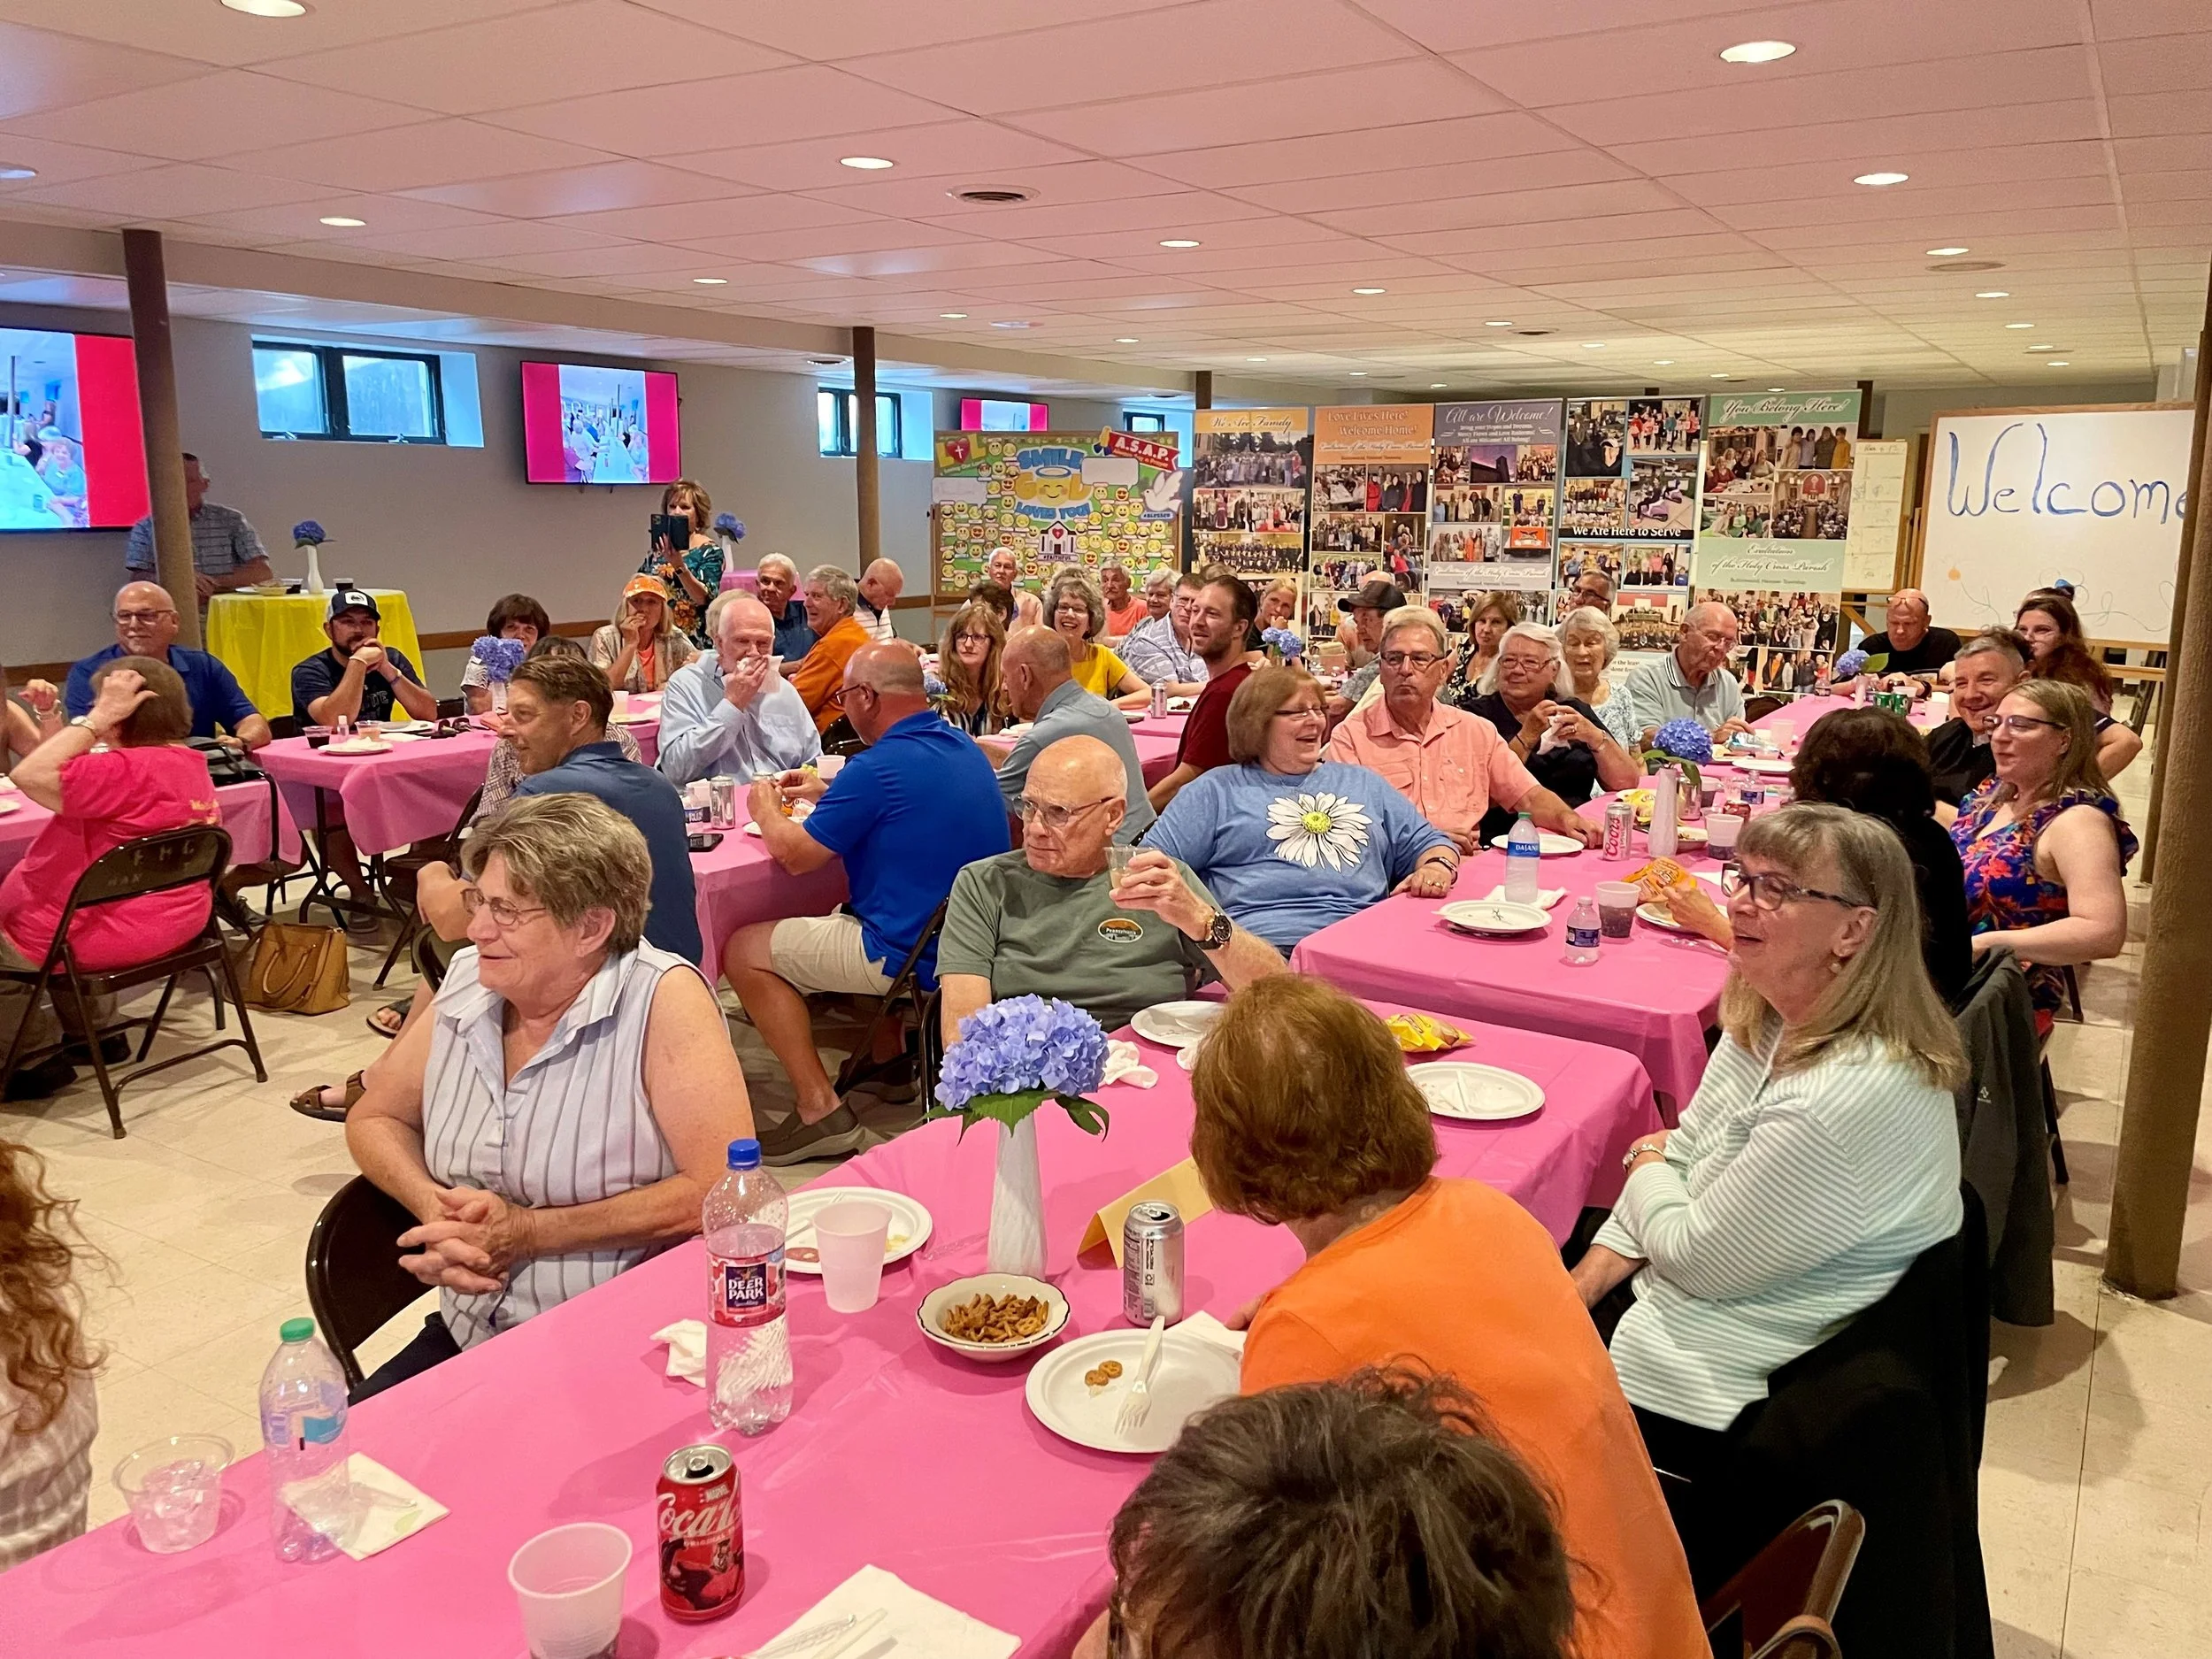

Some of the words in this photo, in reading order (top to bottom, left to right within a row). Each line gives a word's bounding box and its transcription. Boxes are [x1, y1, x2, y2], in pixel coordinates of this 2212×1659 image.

[1328, 411, 1351, 421] Love
[1353, 411, 1379, 421] Lives
[1446, 406, 1468, 423] All
[1469, 411, 1485, 422] are
[1487, 404, 1554, 423] Welcome!
[1720, 400, 1749, 422] You
[1755, 398, 1801, 421] Belong
[1804, 398, 1850, 412] Here!
[1211, 417, 1225, 427] We
[1253, 416, 1292, 434] Family
[1339, 425, 1382, 435] Welcome
[1385, 425, 1418, 435] Home!
[1017, 449, 1084, 469] SMILE
[1016, 502, 1056, 520] LOVES
[1573, 526, 1589, 536] We
[1591, 526, 1609, 536] Are
[1611, 526, 1636, 536] Here
[1638, 528, 1648, 537] to
[1650, 527, 1681, 537] Serve
[1737, 558, 1763, 576] Holy
[1765, 559, 1789, 570] Cross
[1793, 560, 1828, 572] Parish
[1605, 816, 1620, 856] Coors
[728, 1276, 764, 1290] DEER
[728, 1287, 764, 1300] PARK
